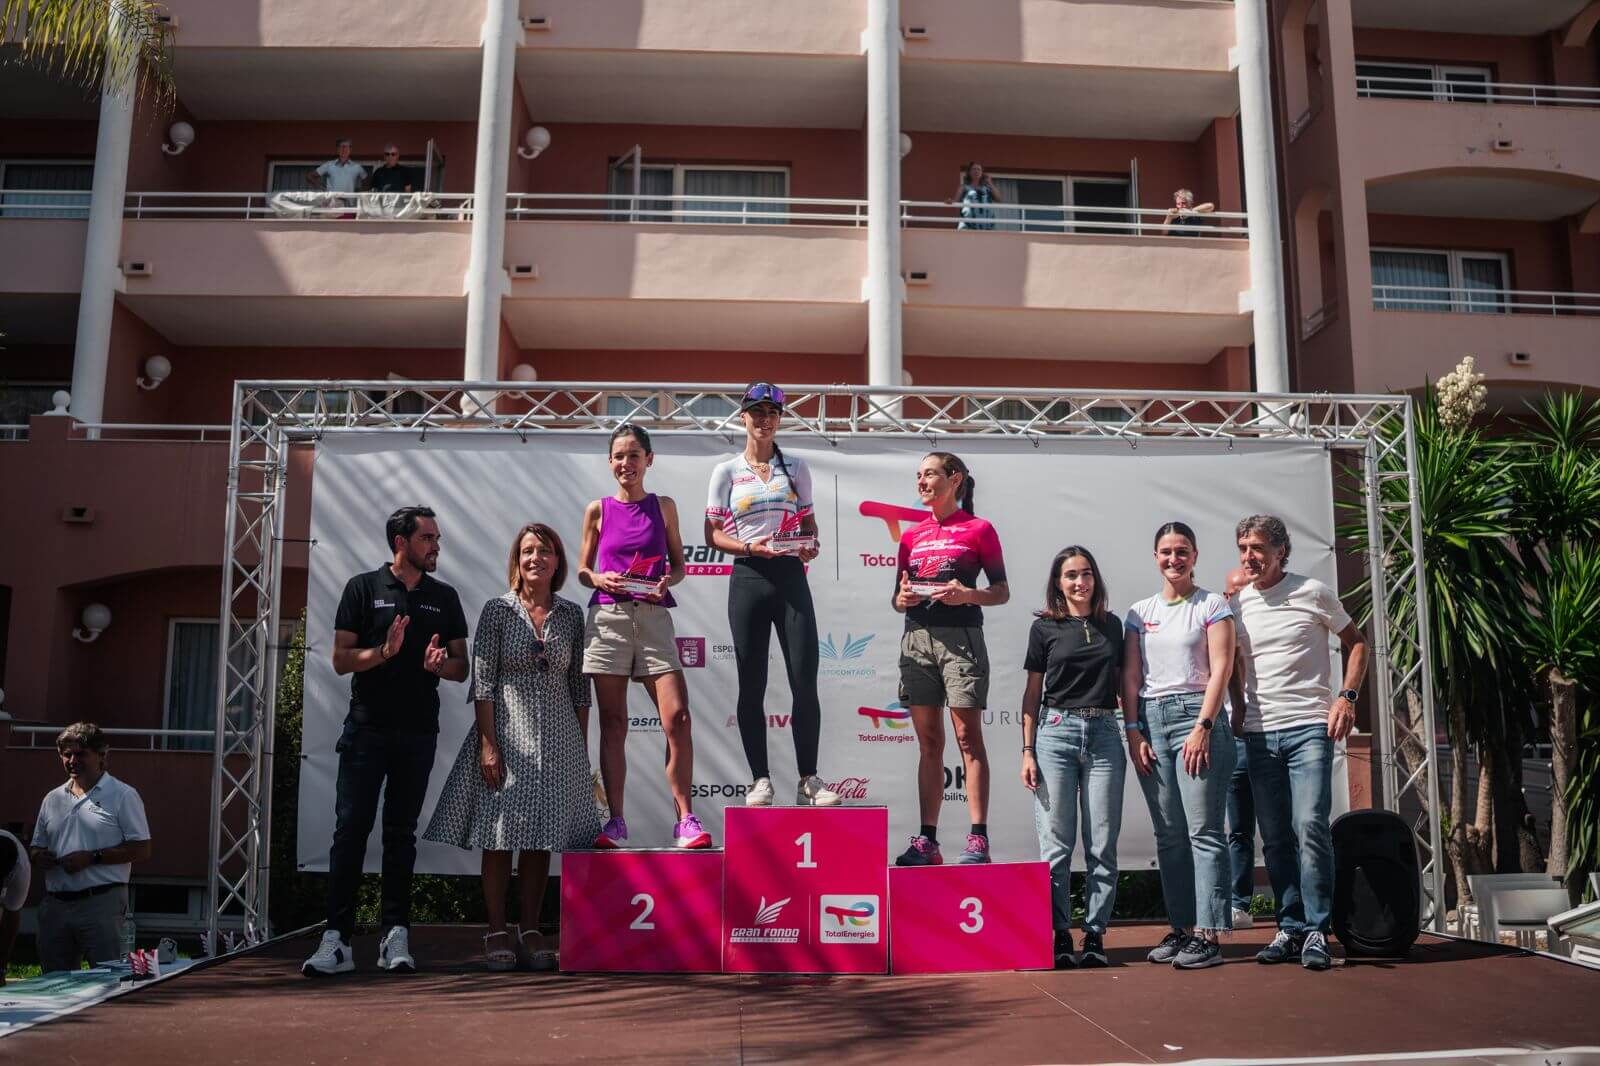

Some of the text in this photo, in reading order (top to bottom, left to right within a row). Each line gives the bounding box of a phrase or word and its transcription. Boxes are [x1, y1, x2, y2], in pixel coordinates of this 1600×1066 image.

[860, 553, 897, 567] Tota
[688, 566, 723, 574] ERTO
[858, 733, 915, 743] TotalEnergies
[793, 832, 818, 869] 1
[629, 893, 655, 931] 2
[958, 896, 984, 934] 3
[824, 930, 875, 939] TotalEnergies
